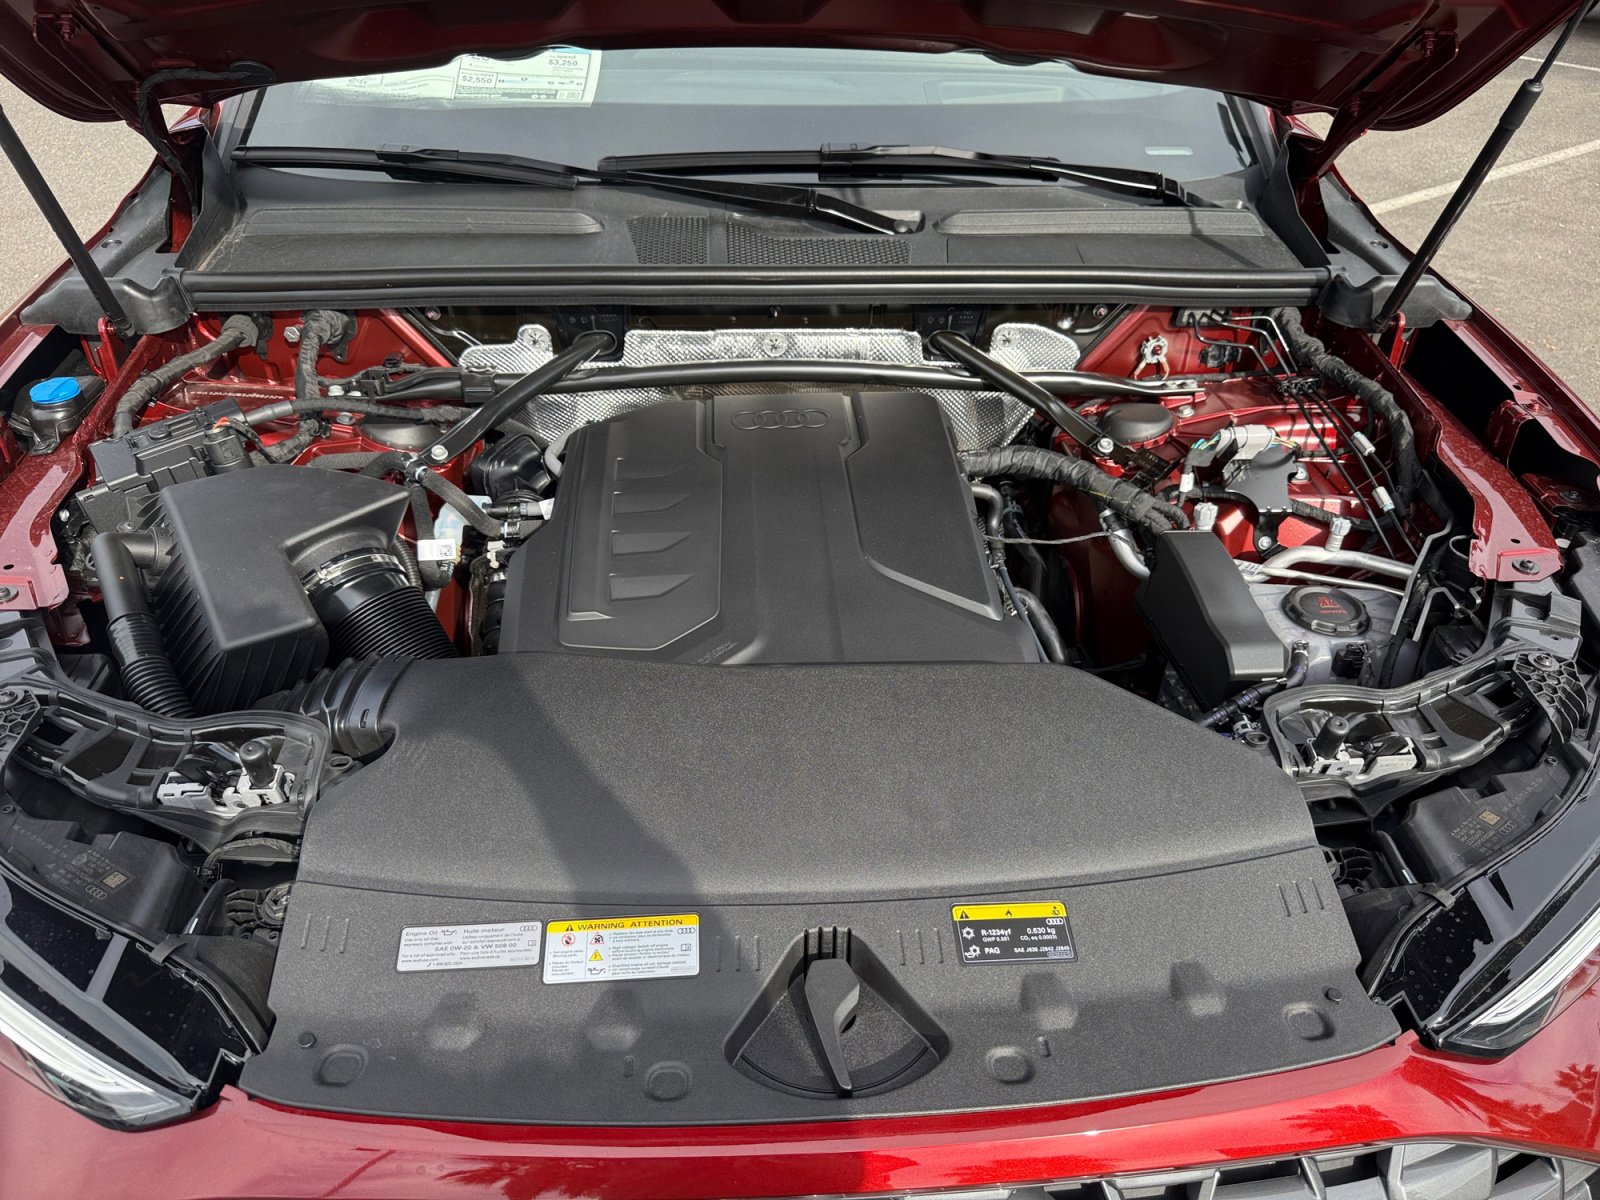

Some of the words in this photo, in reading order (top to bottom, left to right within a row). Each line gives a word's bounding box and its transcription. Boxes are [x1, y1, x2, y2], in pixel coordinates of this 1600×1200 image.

[548, 58, 578, 66] $3,250
[462, 75, 492, 84] $2,550
[578, 922, 624, 930] WARNING
[630, 919, 683, 928] ATTENTION
[980, 928, 1011, 936] R-1234yf
[1046, 926, 1056, 934] kg
[984, 946, 1000, 954] PAG
